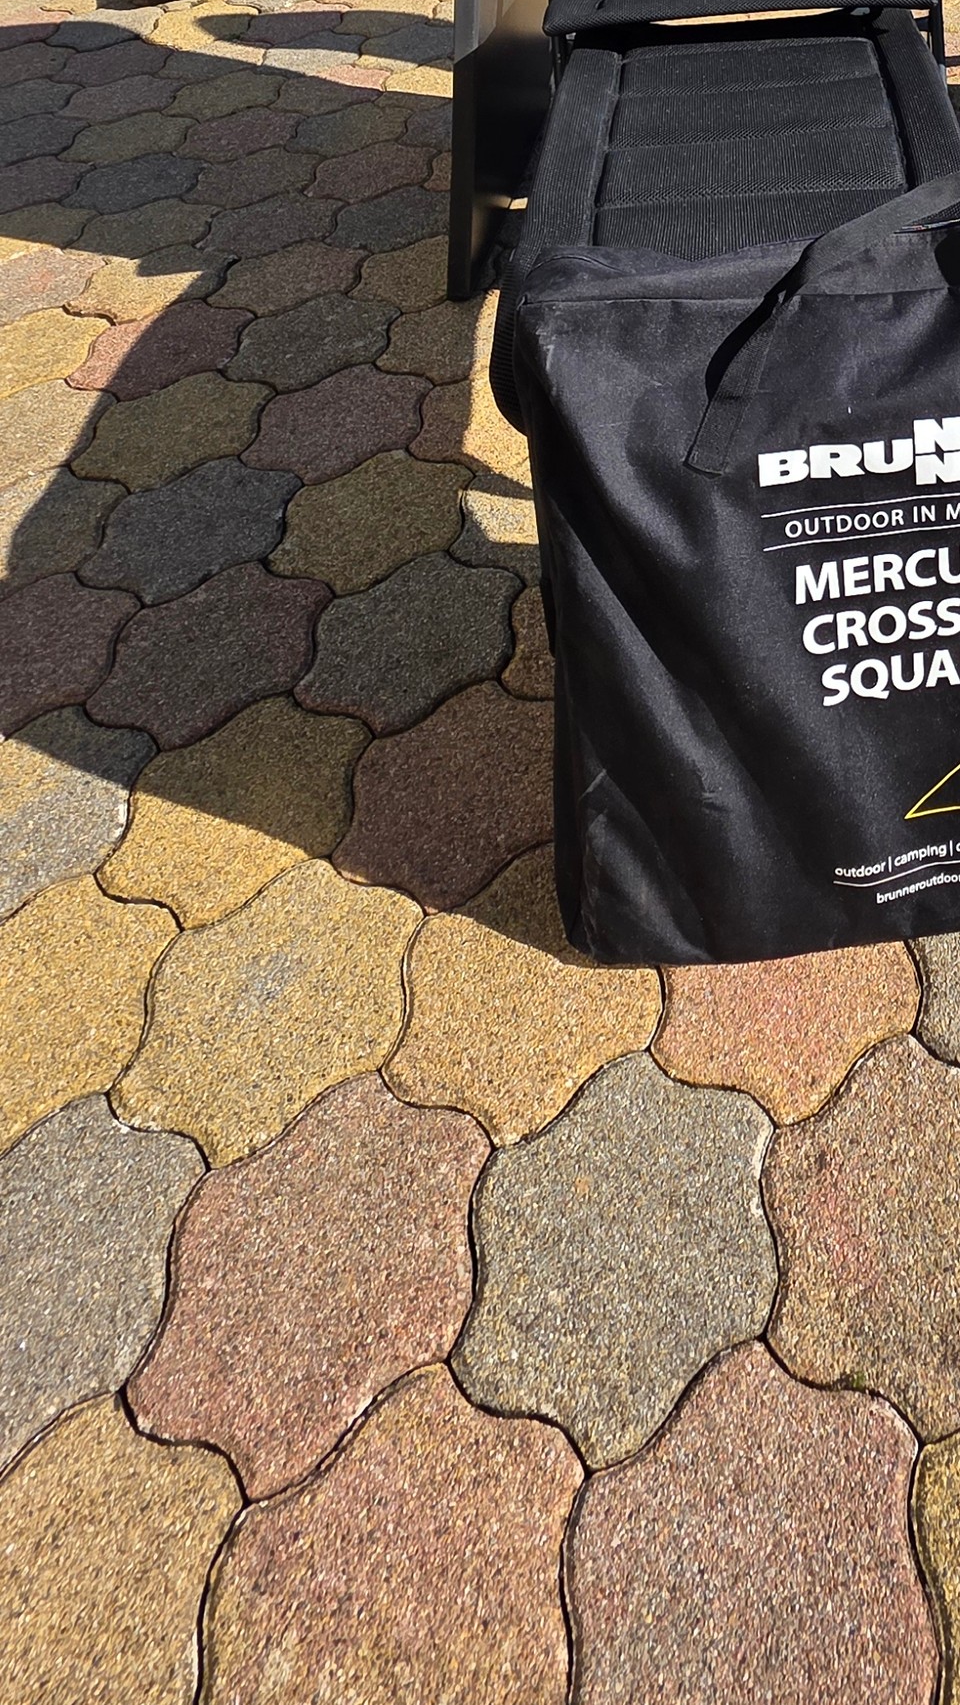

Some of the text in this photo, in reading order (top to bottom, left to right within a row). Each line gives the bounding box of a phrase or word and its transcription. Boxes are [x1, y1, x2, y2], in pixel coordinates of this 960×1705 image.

[784, 508, 905, 538] OUTDOOR
[913, 504, 936, 523] IN
[834, 861, 887, 878] outdoor
[893, 844, 947, 867] camping
